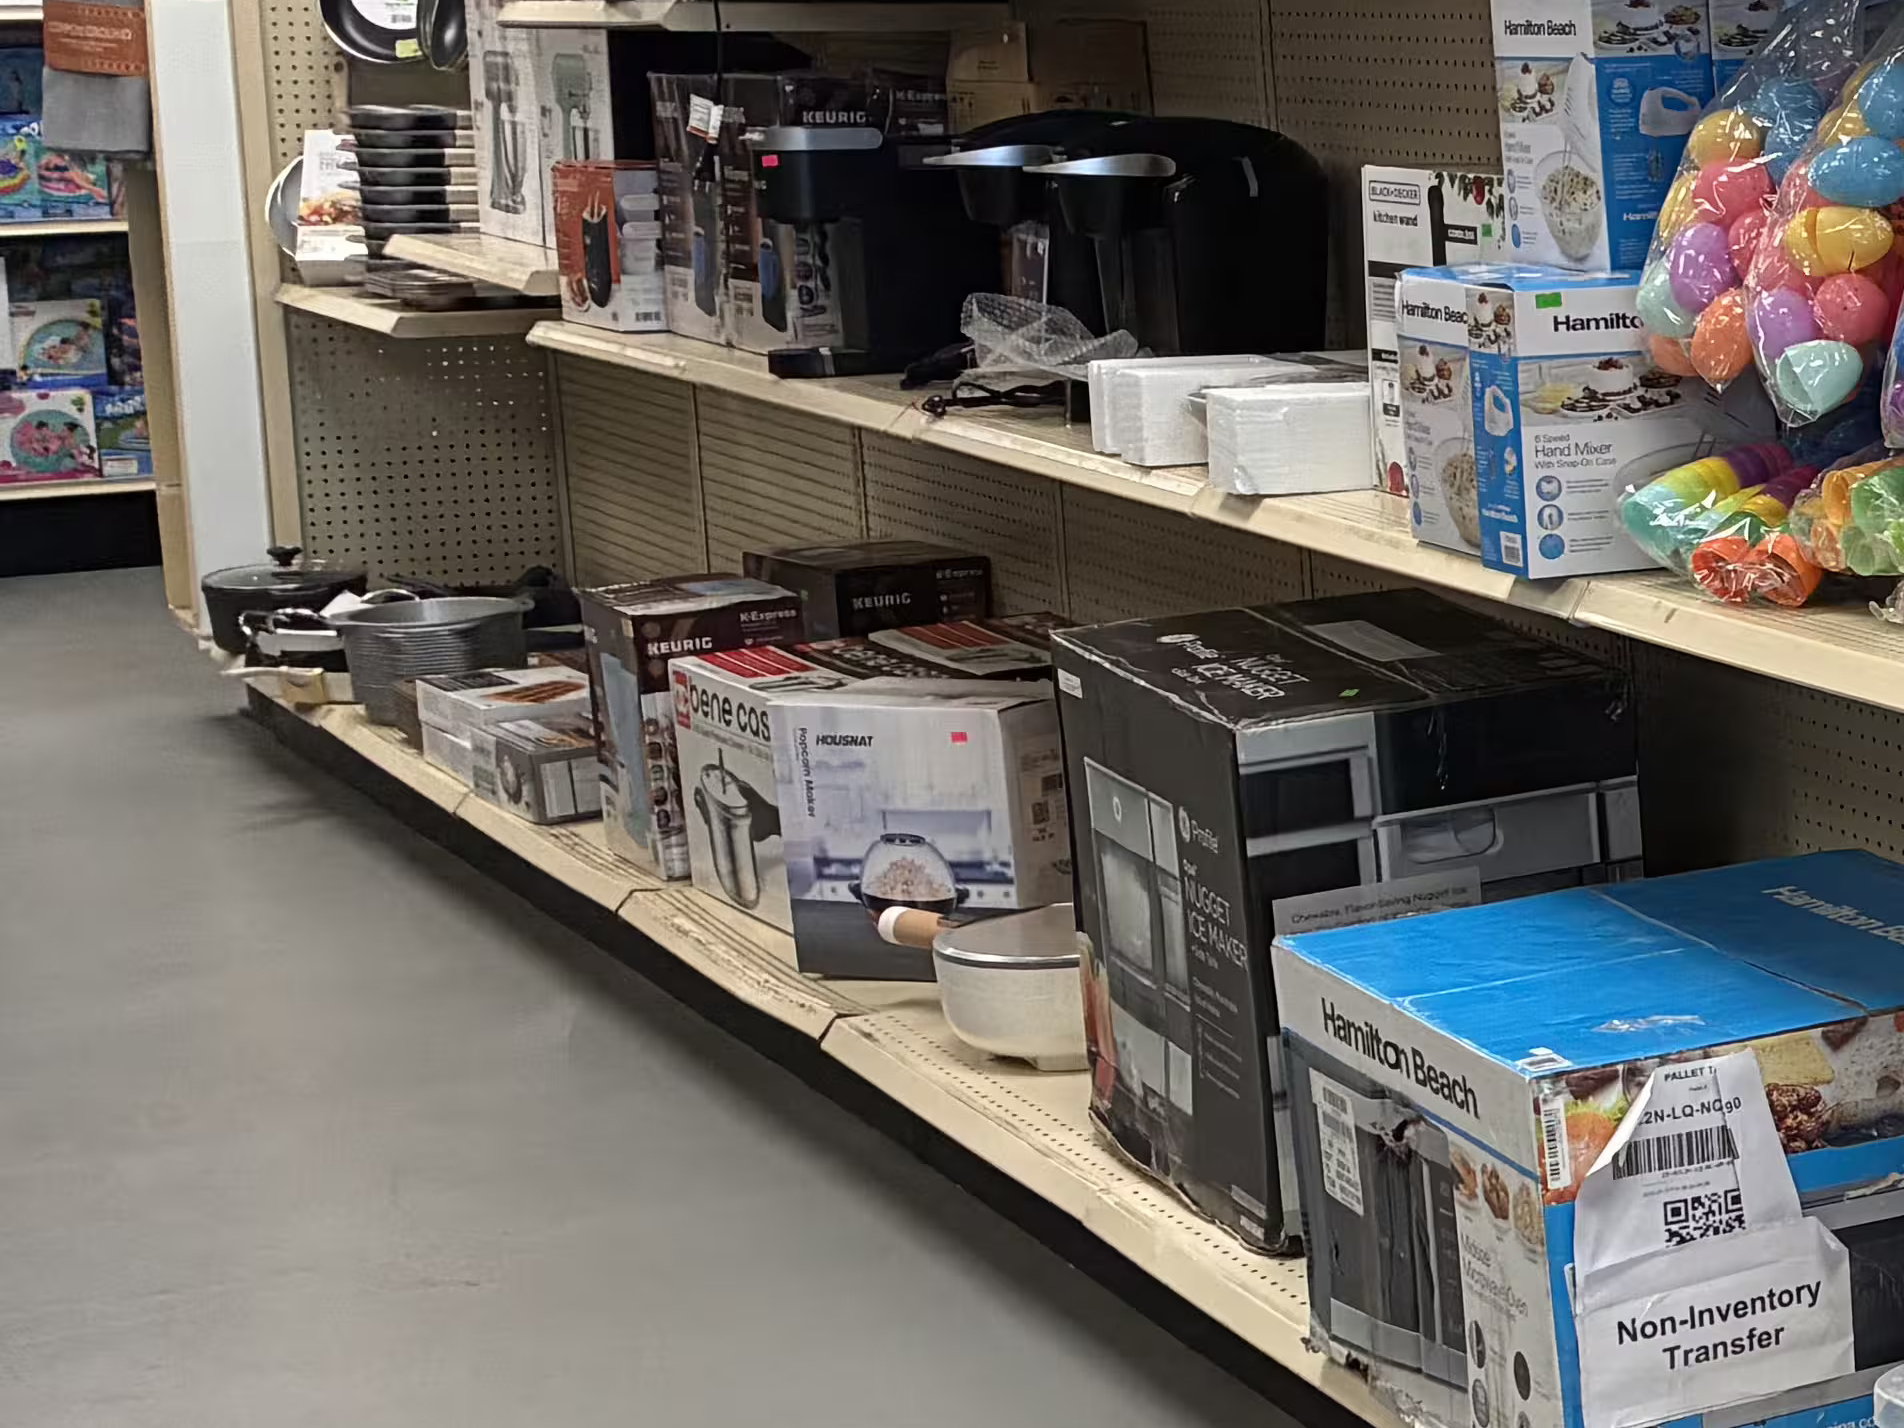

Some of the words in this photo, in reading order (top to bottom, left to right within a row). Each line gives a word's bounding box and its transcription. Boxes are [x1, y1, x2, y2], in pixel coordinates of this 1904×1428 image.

[1504, 20, 1545, 36] Hamilton
[1547, 20, 1576, 36] Beach
[803, 110, 866, 124] KEURIG
[1401, 301, 1442, 321] Hamilton
[1444, 305, 1468, 323] Beac
[1553, 313, 1643, 332] Hamilto
[1534, 443, 1571, 458] Hand
[1574, 442, 1612, 457] Mixer
[852, 593, 911, 610] KEURIG
[647, 637, 713, 655] KEURIG
[688, 675, 732, 729] bene
[737, 699, 771, 743] cas
[799, 727, 811, 777] Popcorn
[816, 735, 873, 748] HOUSNAT
[1184, 876, 1232, 927] NUGGET
[1762, 885, 1884, 935] Hamilton
[1208, 919, 1249, 972] MAKER
[1321, 997, 1410, 1080] Hamilton
[1411, 1046, 1481, 1120] Beach
[1664, 1067, 1705, 1082] PALLET
[1617, 1280, 1822, 1347] Non-Inventory
[1663, 1327, 1785, 1371] Transfer
